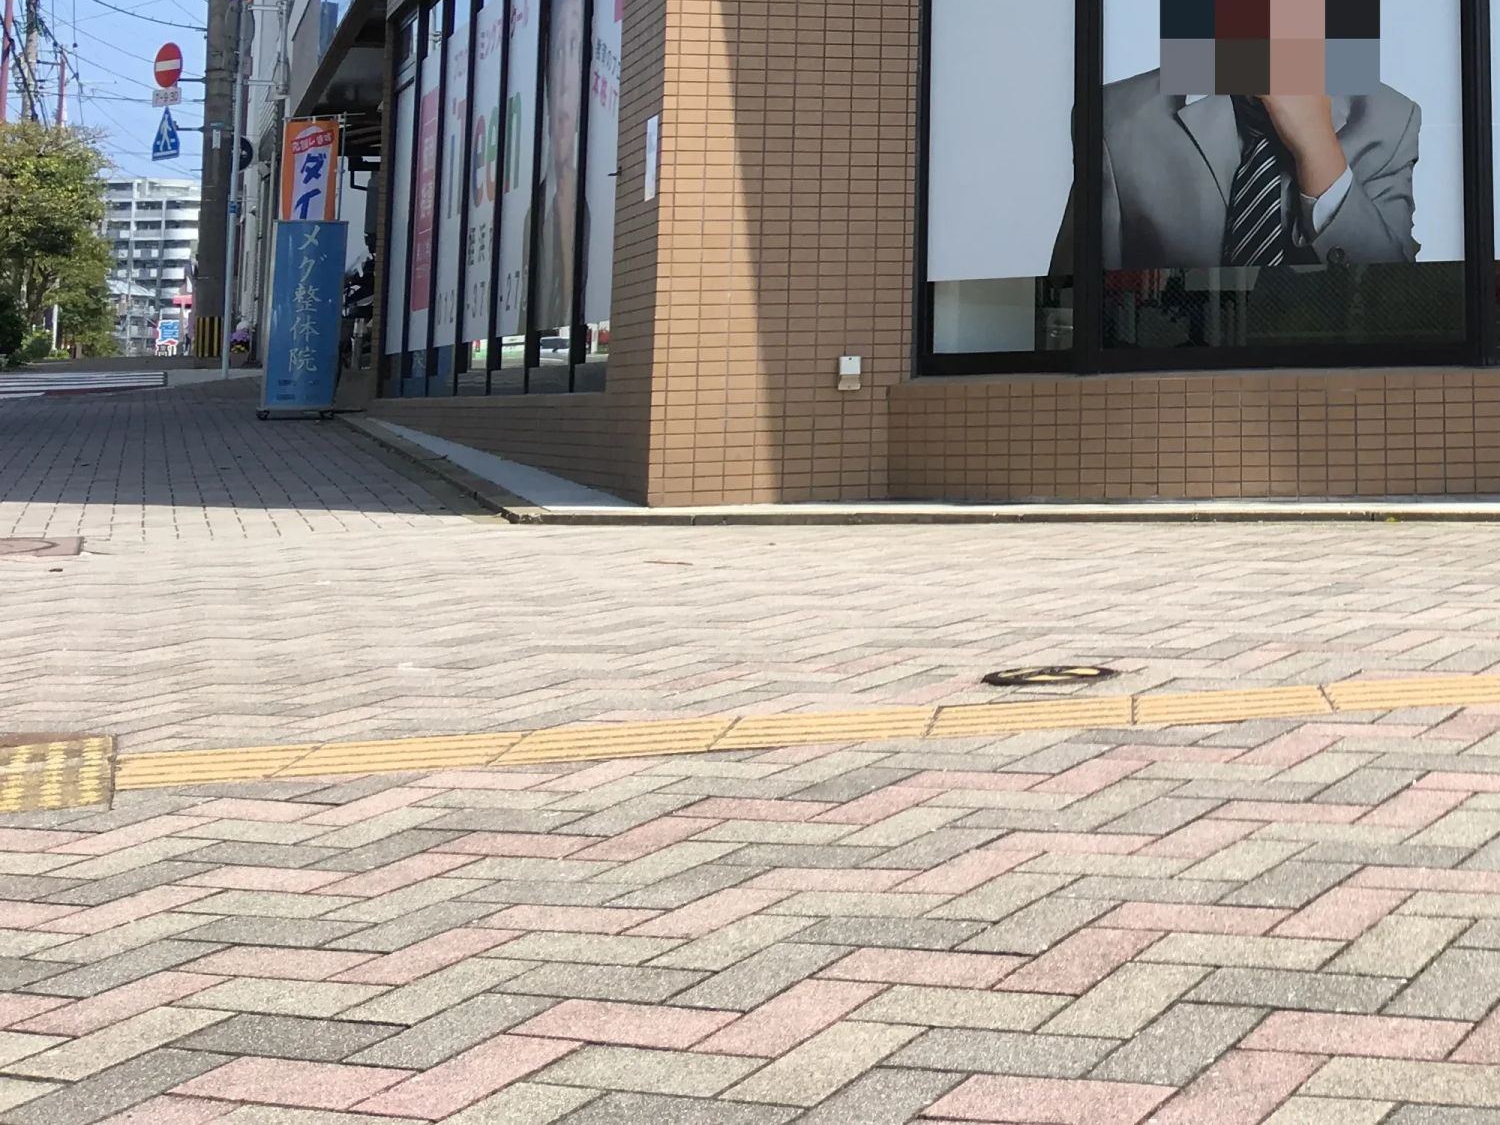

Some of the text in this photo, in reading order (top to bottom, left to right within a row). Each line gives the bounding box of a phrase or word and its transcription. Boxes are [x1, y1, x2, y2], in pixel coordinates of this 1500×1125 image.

[288, 225, 327, 373] メグ整体院
